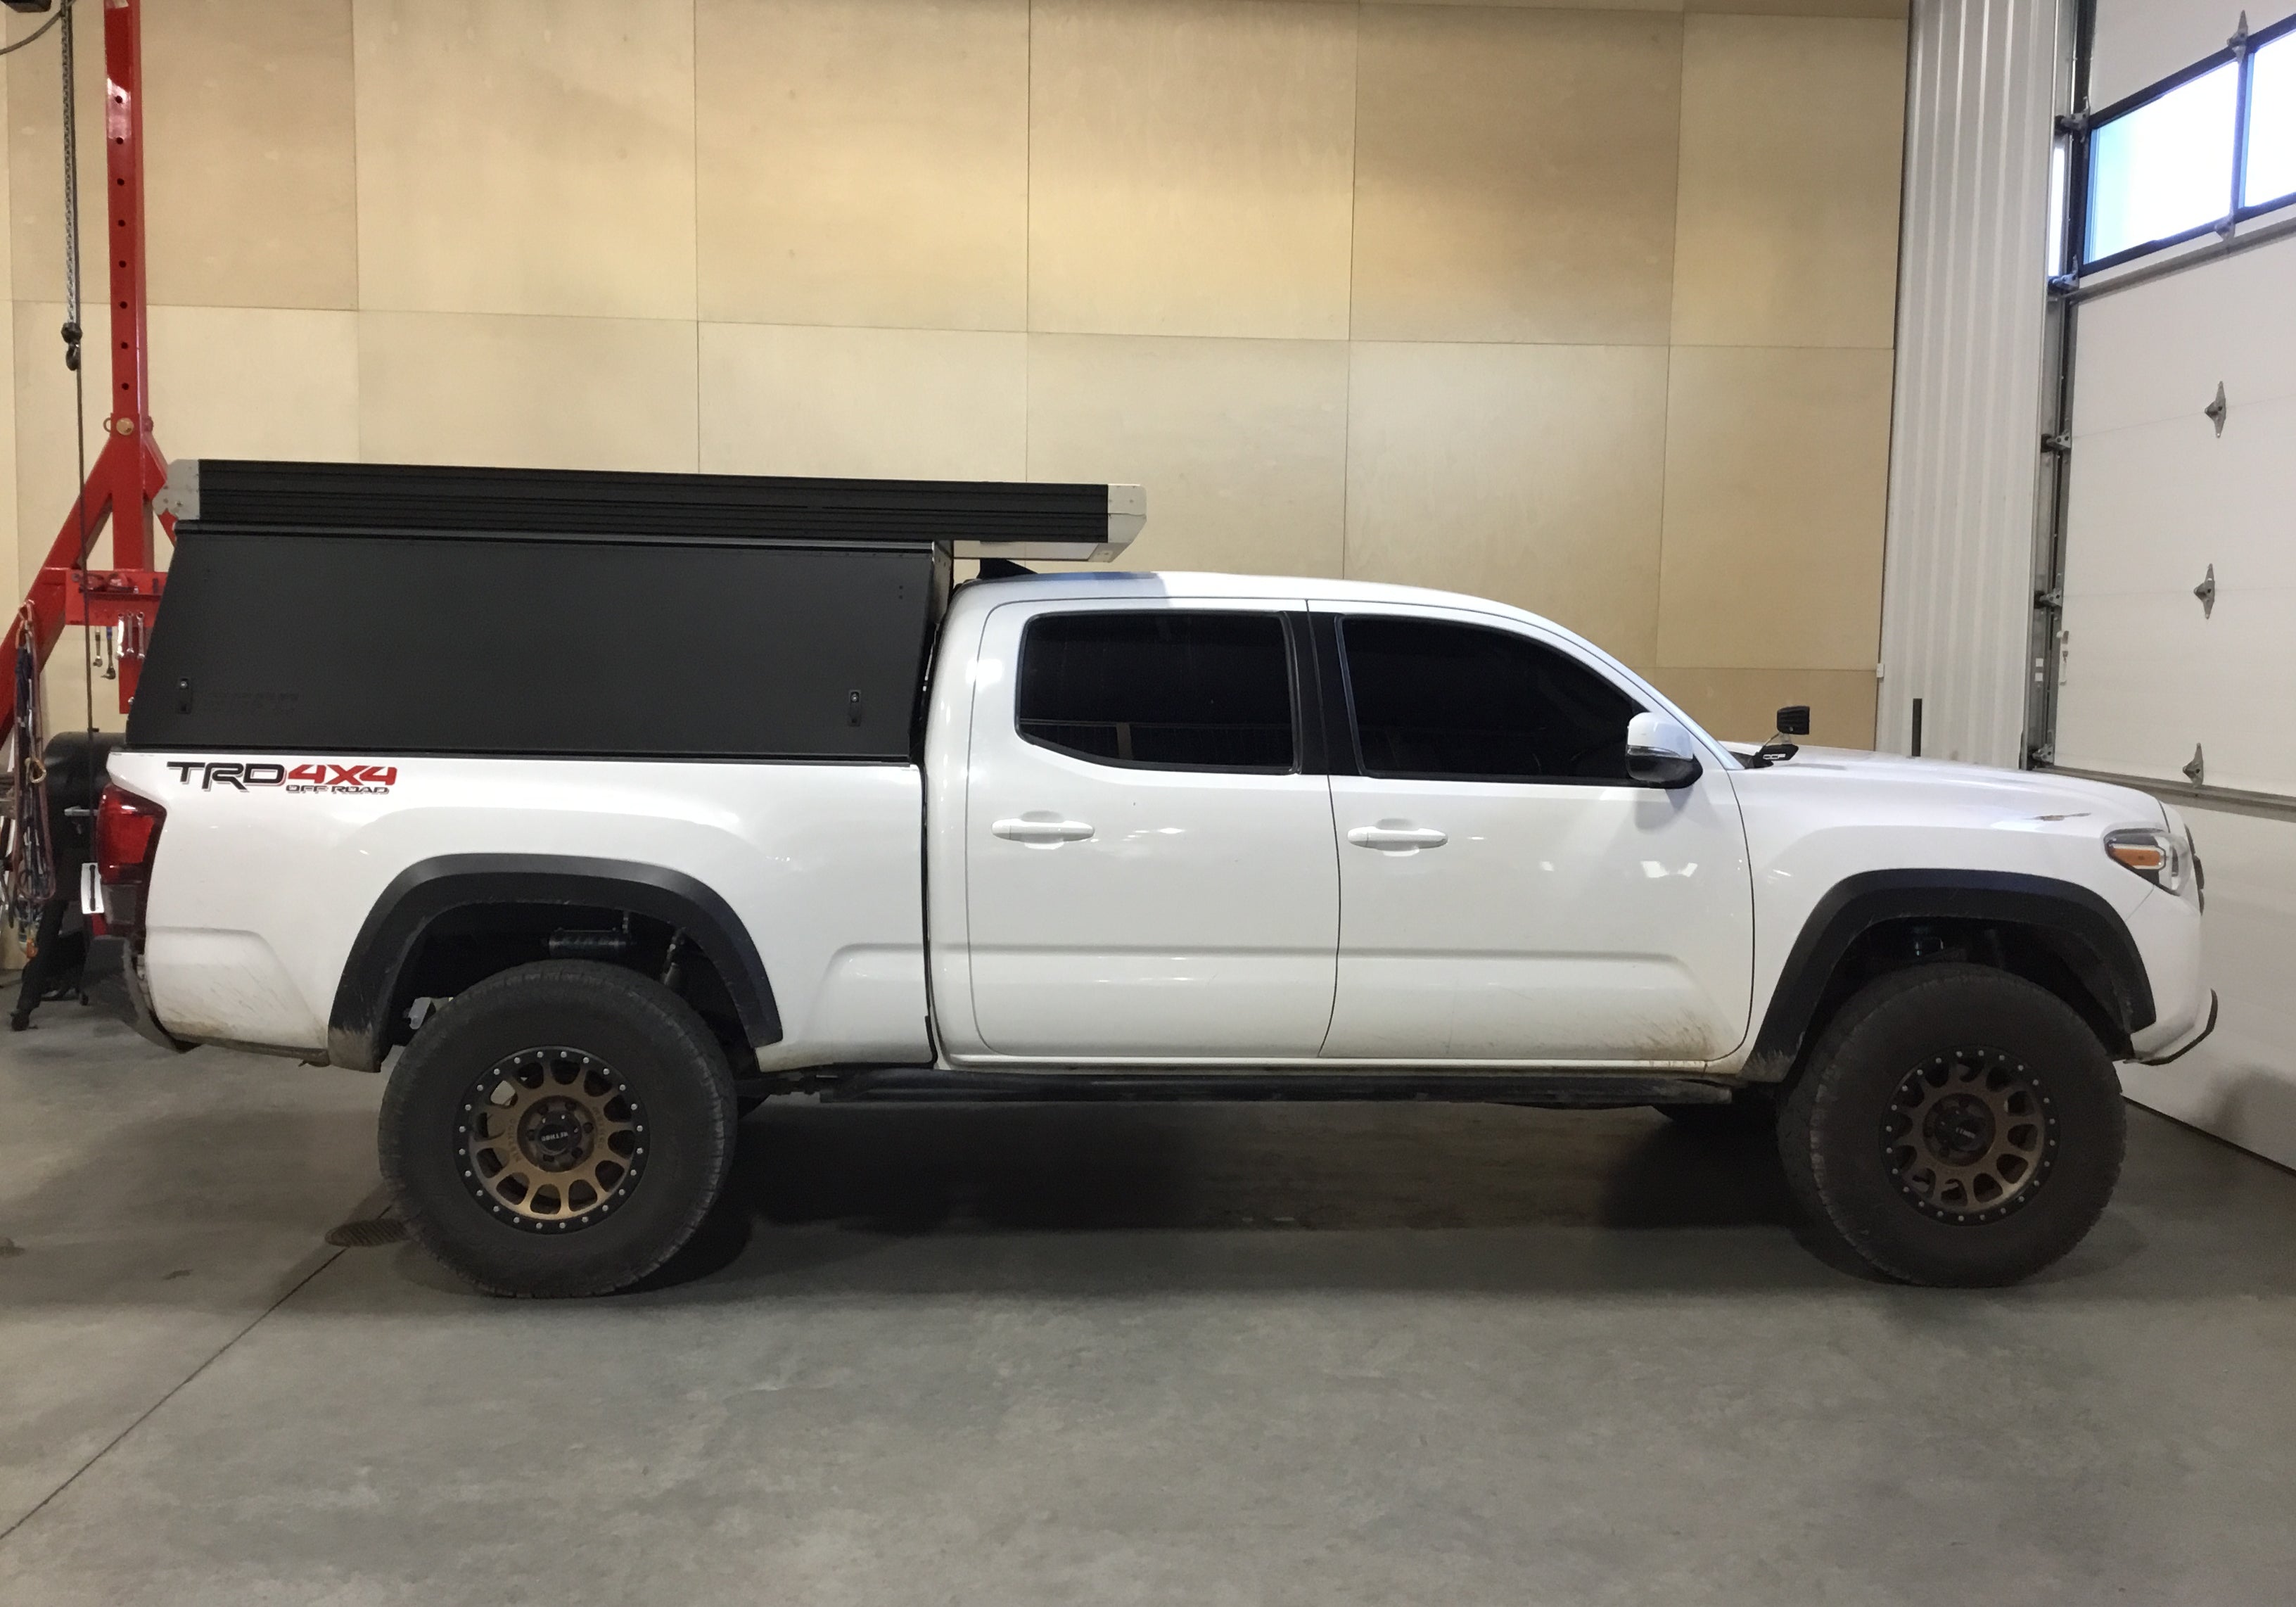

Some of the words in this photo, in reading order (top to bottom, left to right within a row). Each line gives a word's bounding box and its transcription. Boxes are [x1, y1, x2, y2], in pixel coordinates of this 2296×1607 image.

[167, 761, 286, 792] TRD
[286, 785, 329, 794] OFF
[331, 785, 390, 795] ROAD
